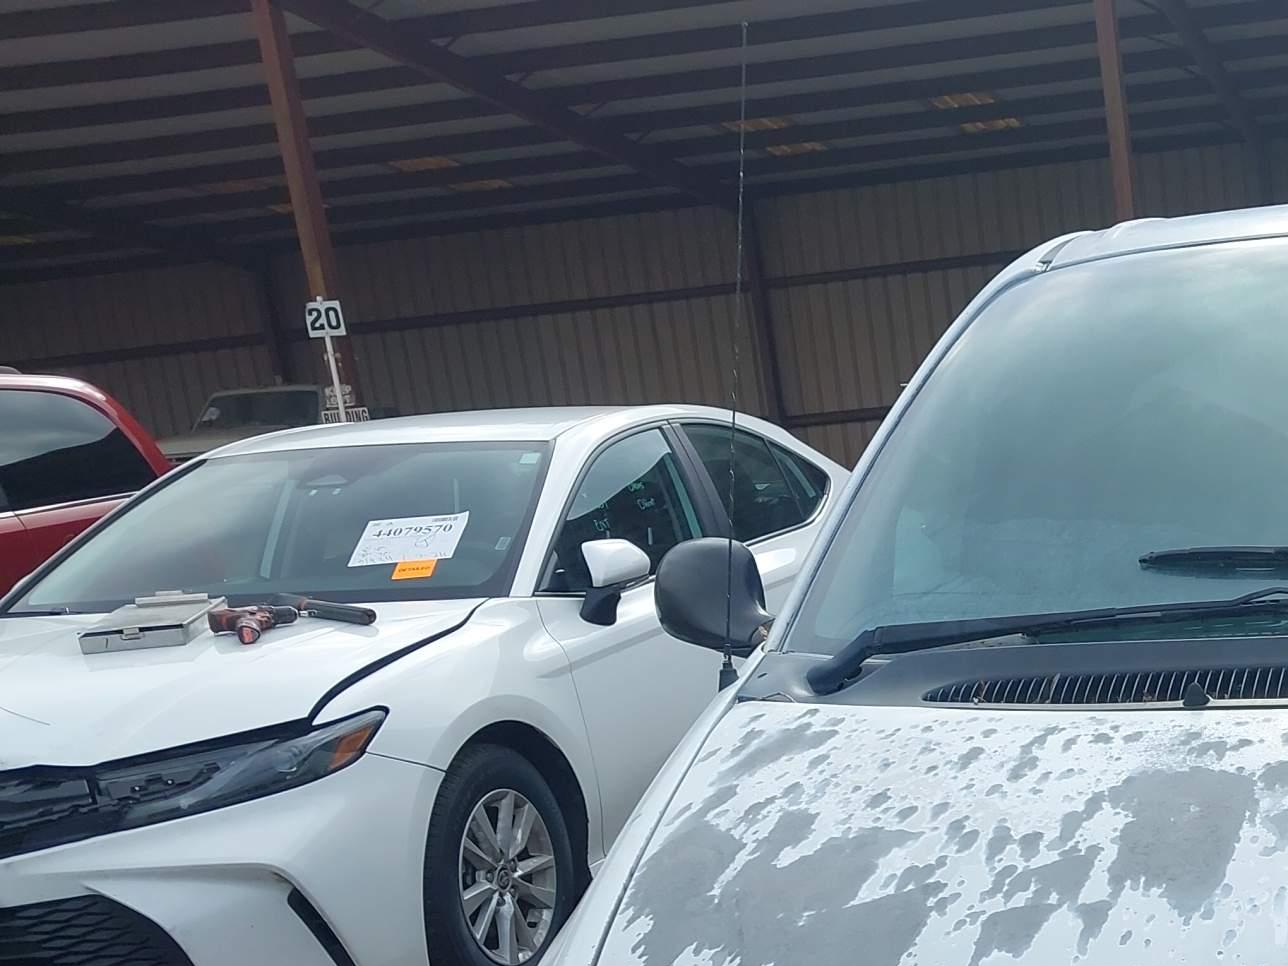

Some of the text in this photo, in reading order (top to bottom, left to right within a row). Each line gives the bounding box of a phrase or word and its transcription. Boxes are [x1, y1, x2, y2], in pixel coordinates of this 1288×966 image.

[307, 307, 341, 331] 20
[323, 409, 369, 423] BUIDING
[372, 523, 453, 538] 44079570
